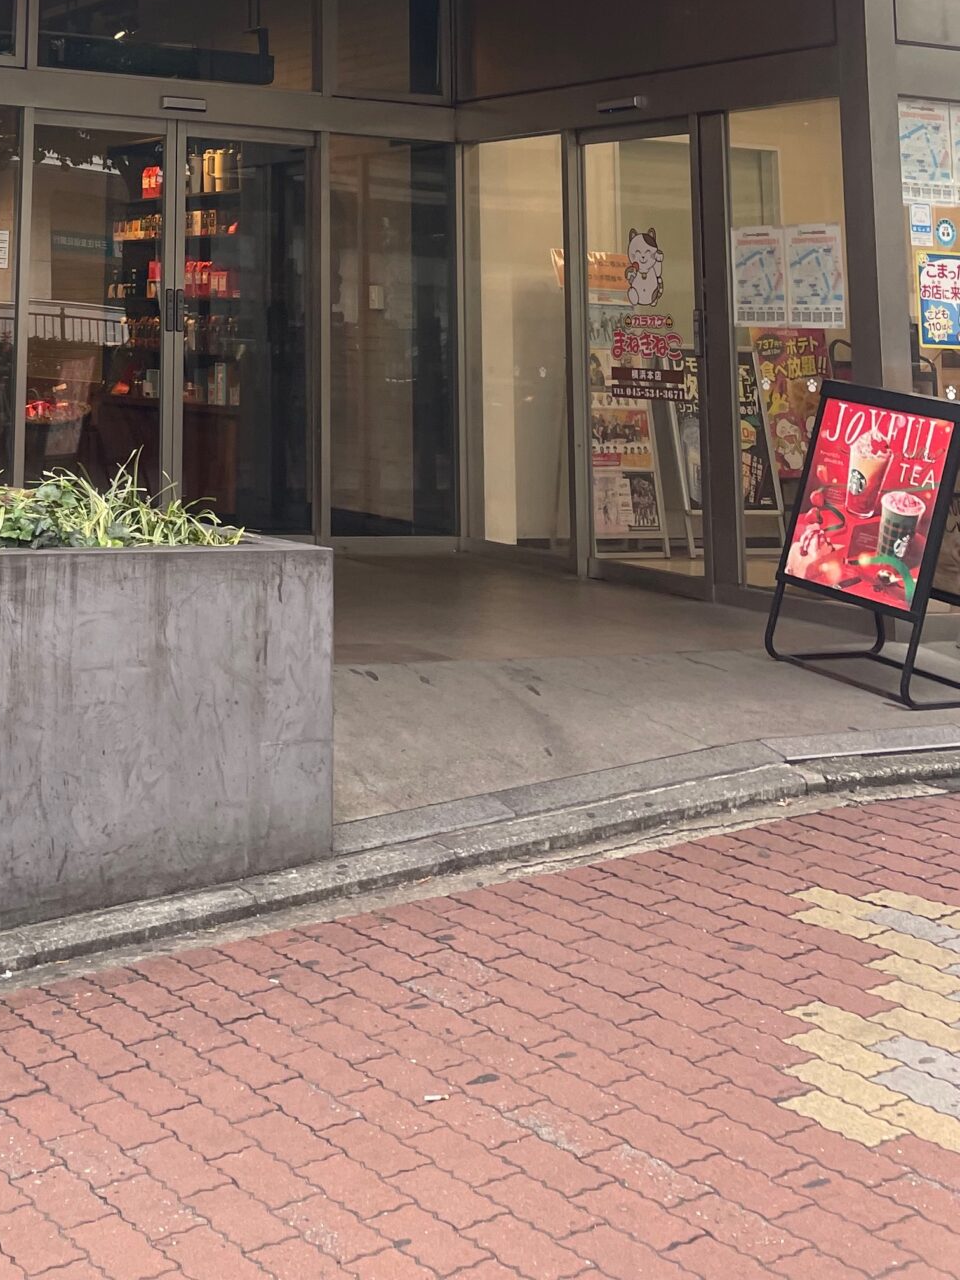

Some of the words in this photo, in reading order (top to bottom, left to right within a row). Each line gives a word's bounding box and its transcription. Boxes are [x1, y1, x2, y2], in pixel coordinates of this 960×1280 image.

[631, 315, 667, 328] カラオケ
[611, 328, 684, 361] まねきねこ
[785, 335, 819, 355] ポテト
[826, 402, 937, 464] JOYFUL
[899, 462, 935, 490] TEA
